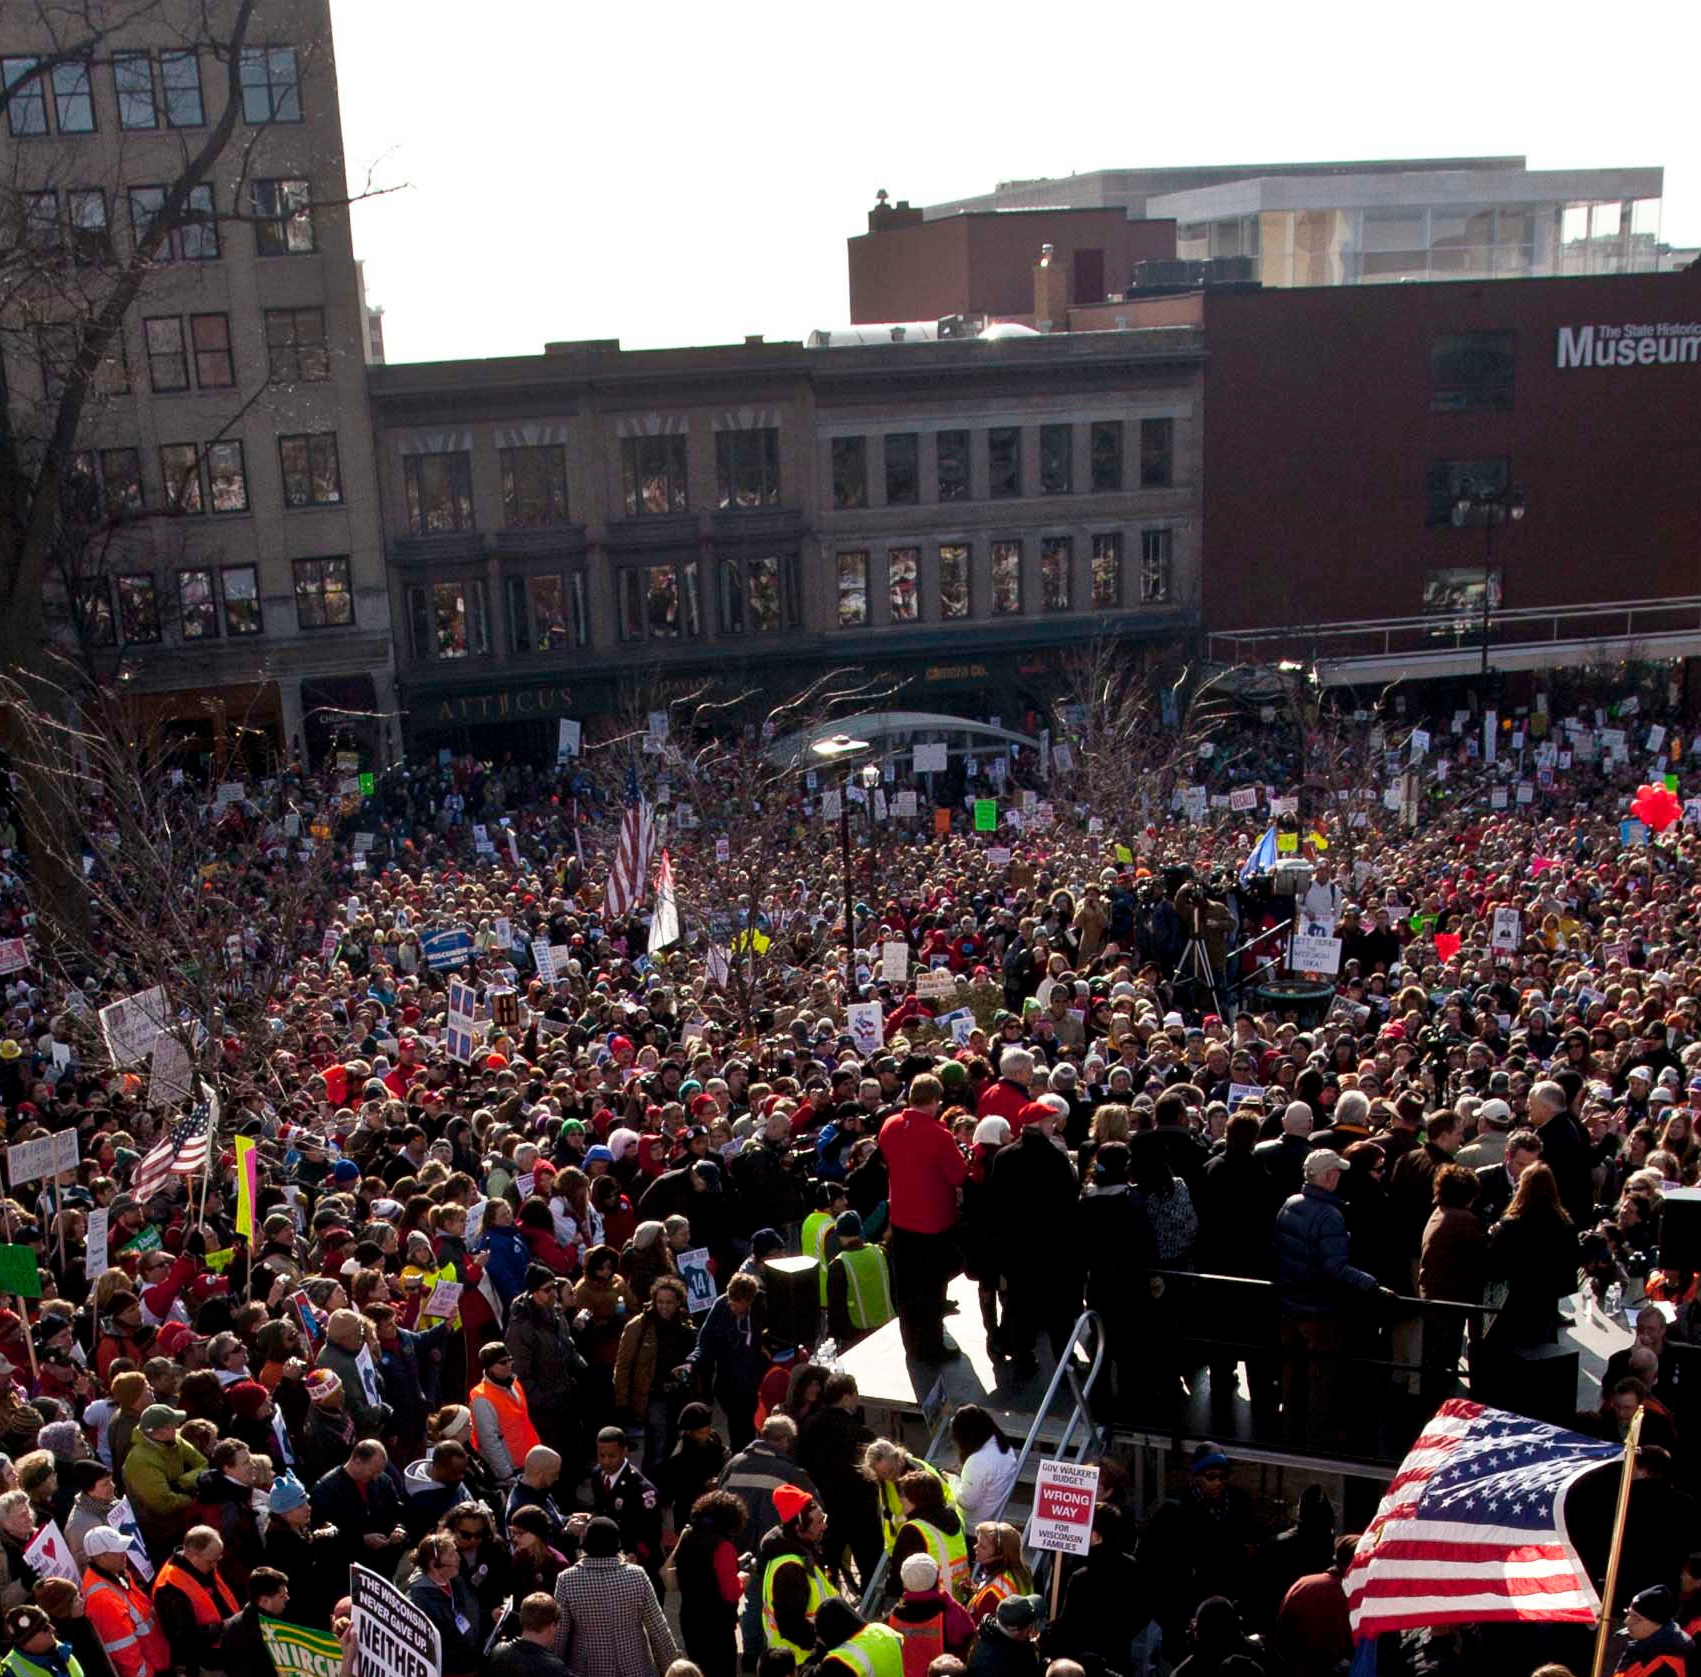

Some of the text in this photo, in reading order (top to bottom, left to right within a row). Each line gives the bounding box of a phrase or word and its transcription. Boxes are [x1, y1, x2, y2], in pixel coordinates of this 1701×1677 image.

[1599, 325, 1621, 338] The
[1624, 324, 1655, 338] State
[441, 688, 571, 720] ATTICUS
[692, 1272, 706, 1295] 14
[1060, 1466, 1097, 1480] WALKER'S
[1043, 1489, 1090, 1506] WRONG
[1052, 1504, 1078, 1518] WAY
[1054, 1523, 1070, 1533] FOR
[1039, 1530, 1083, 1544] WISCONSIN
[1042, 1542, 1077, 1552] FAMILIES
[358, 1573, 381, 1595] THE
[380, 1582, 426, 1633] WISCONSIN
[359, 1591, 428, 1652] NEVER GAVE UP.
